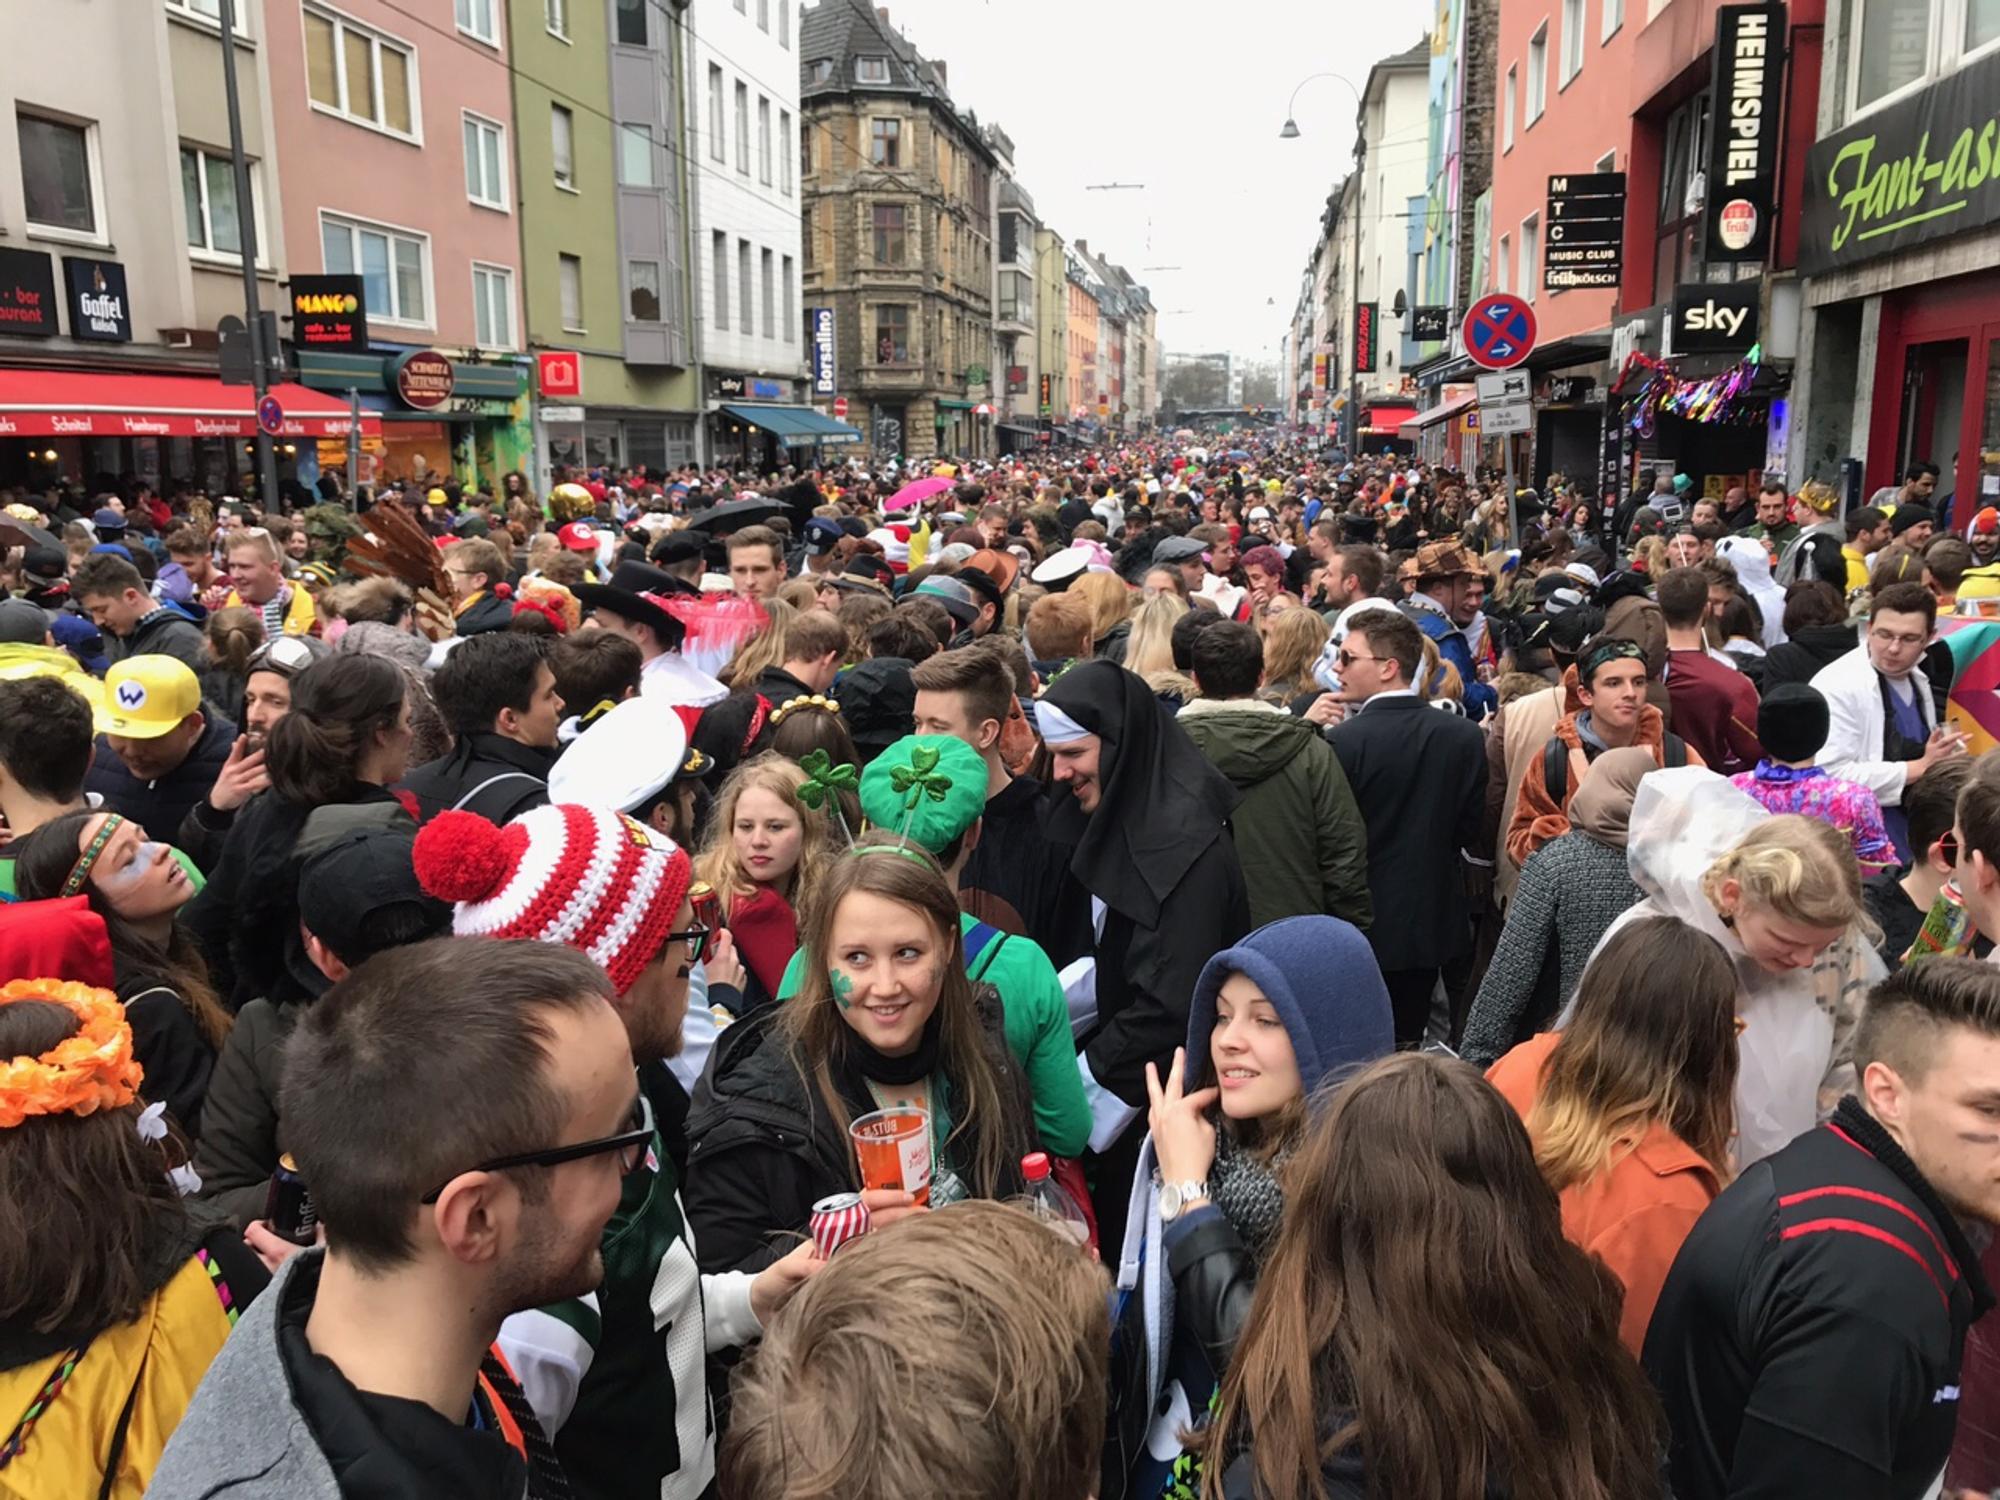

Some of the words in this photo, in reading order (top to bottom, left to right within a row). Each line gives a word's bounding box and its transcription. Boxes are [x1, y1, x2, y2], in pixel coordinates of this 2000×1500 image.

[1726, 14, 1768, 186] HEIMSPIEL
[1552, 178, 1567, 192] M
[1553, 202, 1564, 215] T
[1551, 226, 1564, 240] C
[1549, 251, 1583, 261] MUSIC
[1586, 249, 1615, 260] CLUB
[16, 287, 40, 305] bar
[296, 294, 358, 313] MANGO
[81, 292, 123, 320] Gaffel
[1684, 299, 1749, 337] sky
[816, 310, 833, 391] Borsalino
[721, 378, 742, 392] sky
[119, 685, 144, 706] W
